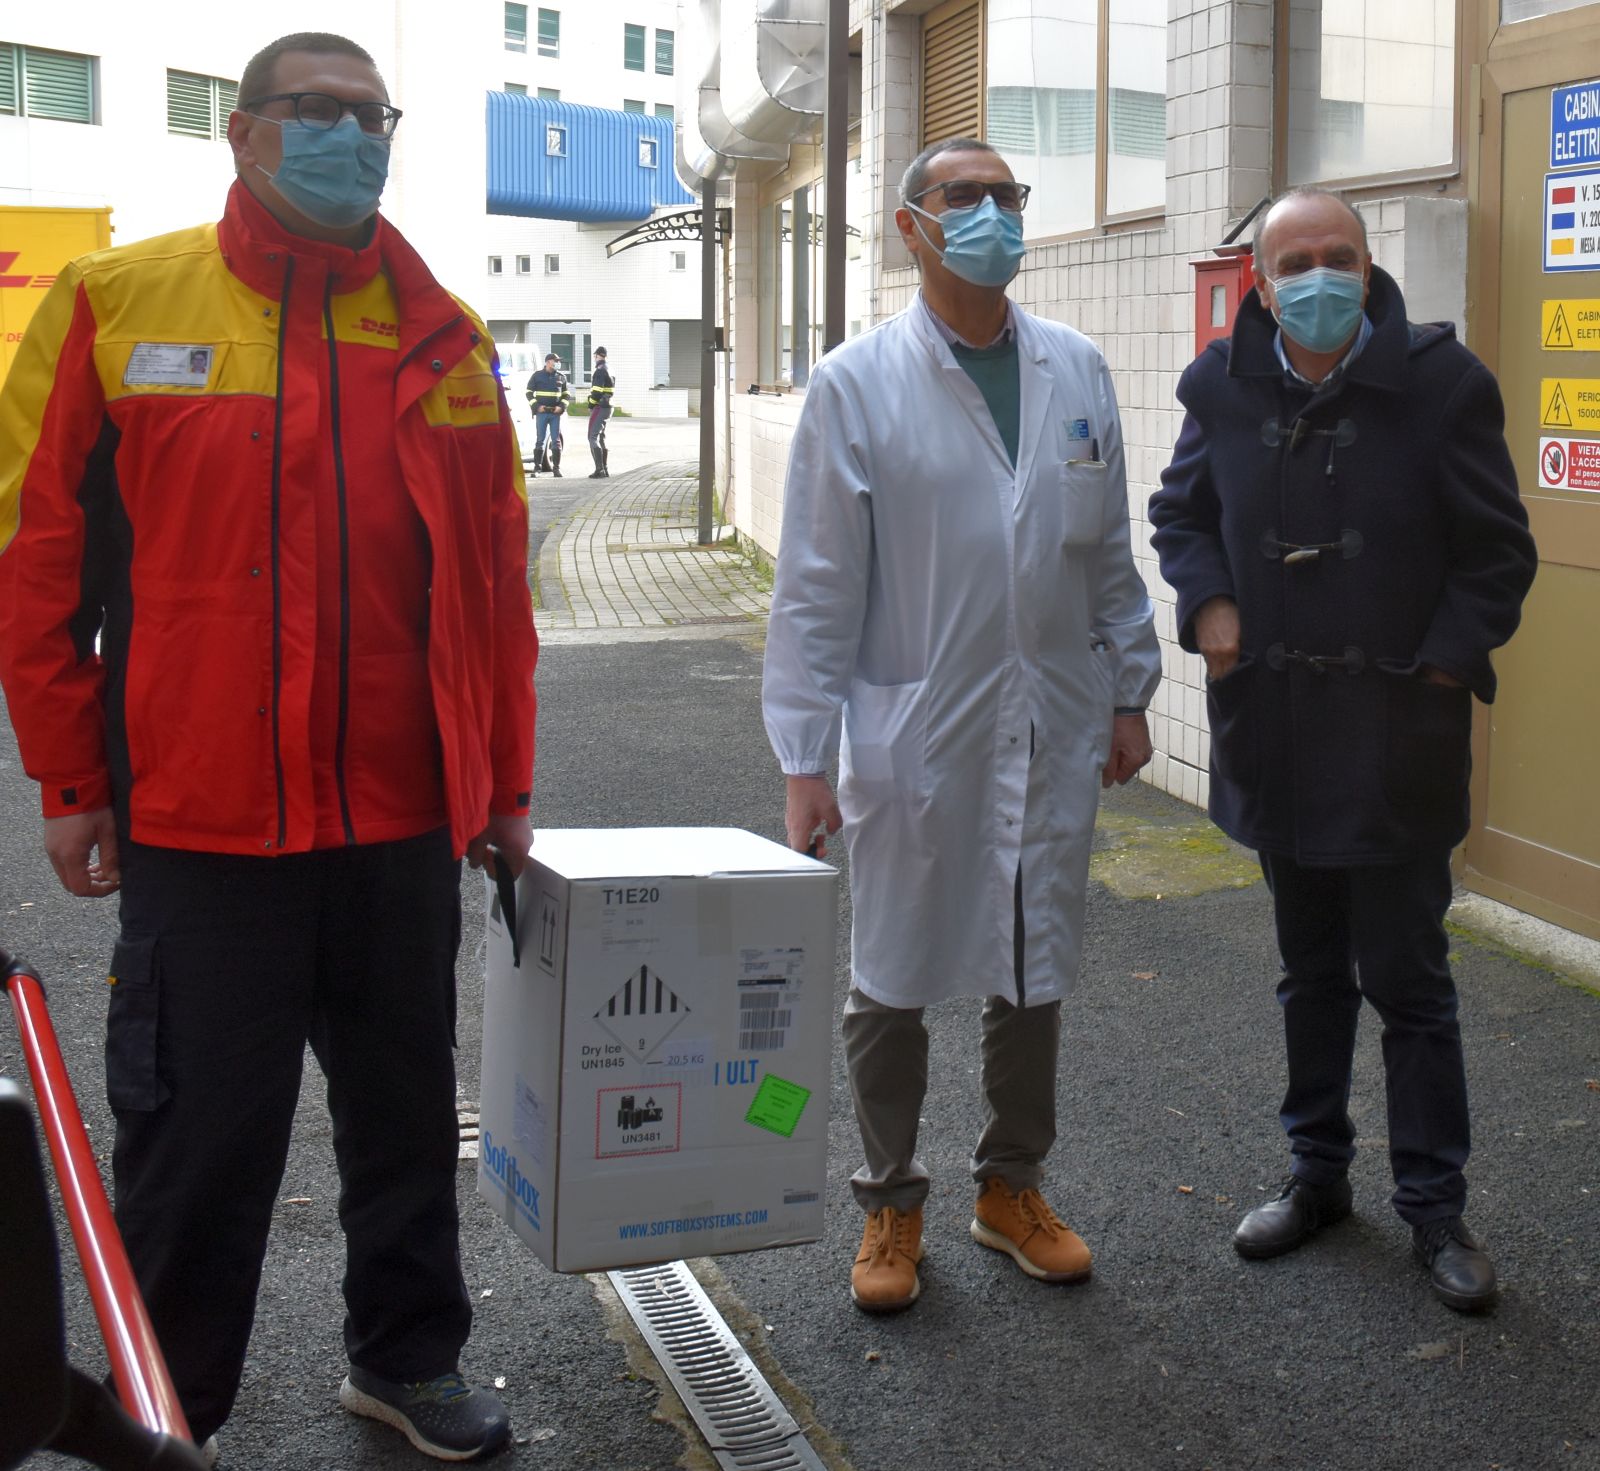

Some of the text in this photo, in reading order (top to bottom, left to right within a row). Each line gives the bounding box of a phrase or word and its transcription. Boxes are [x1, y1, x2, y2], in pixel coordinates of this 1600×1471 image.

[1564, 89, 1600, 122] CABIN
[1555, 127, 1600, 160] ELETTRI
[1581, 185, 1590, 202] V.
[1581, 211, 1588, 228] V.
[602, 887, 660, 905] T1E20
[581, 1044, 622, 1057] Dry Ice
[691, 1054, 705, 1064] KG
[581, 1057, 625, 1070] UN1845
[726, 1059, 760, 1085] ULT
[622, 1132, 662, 1144] UN3481
[483, 1129, 541, 1218] Softbox
[618, 1209, 769, 1240] WWW.SOFTBOXSYSTEMS.COM
